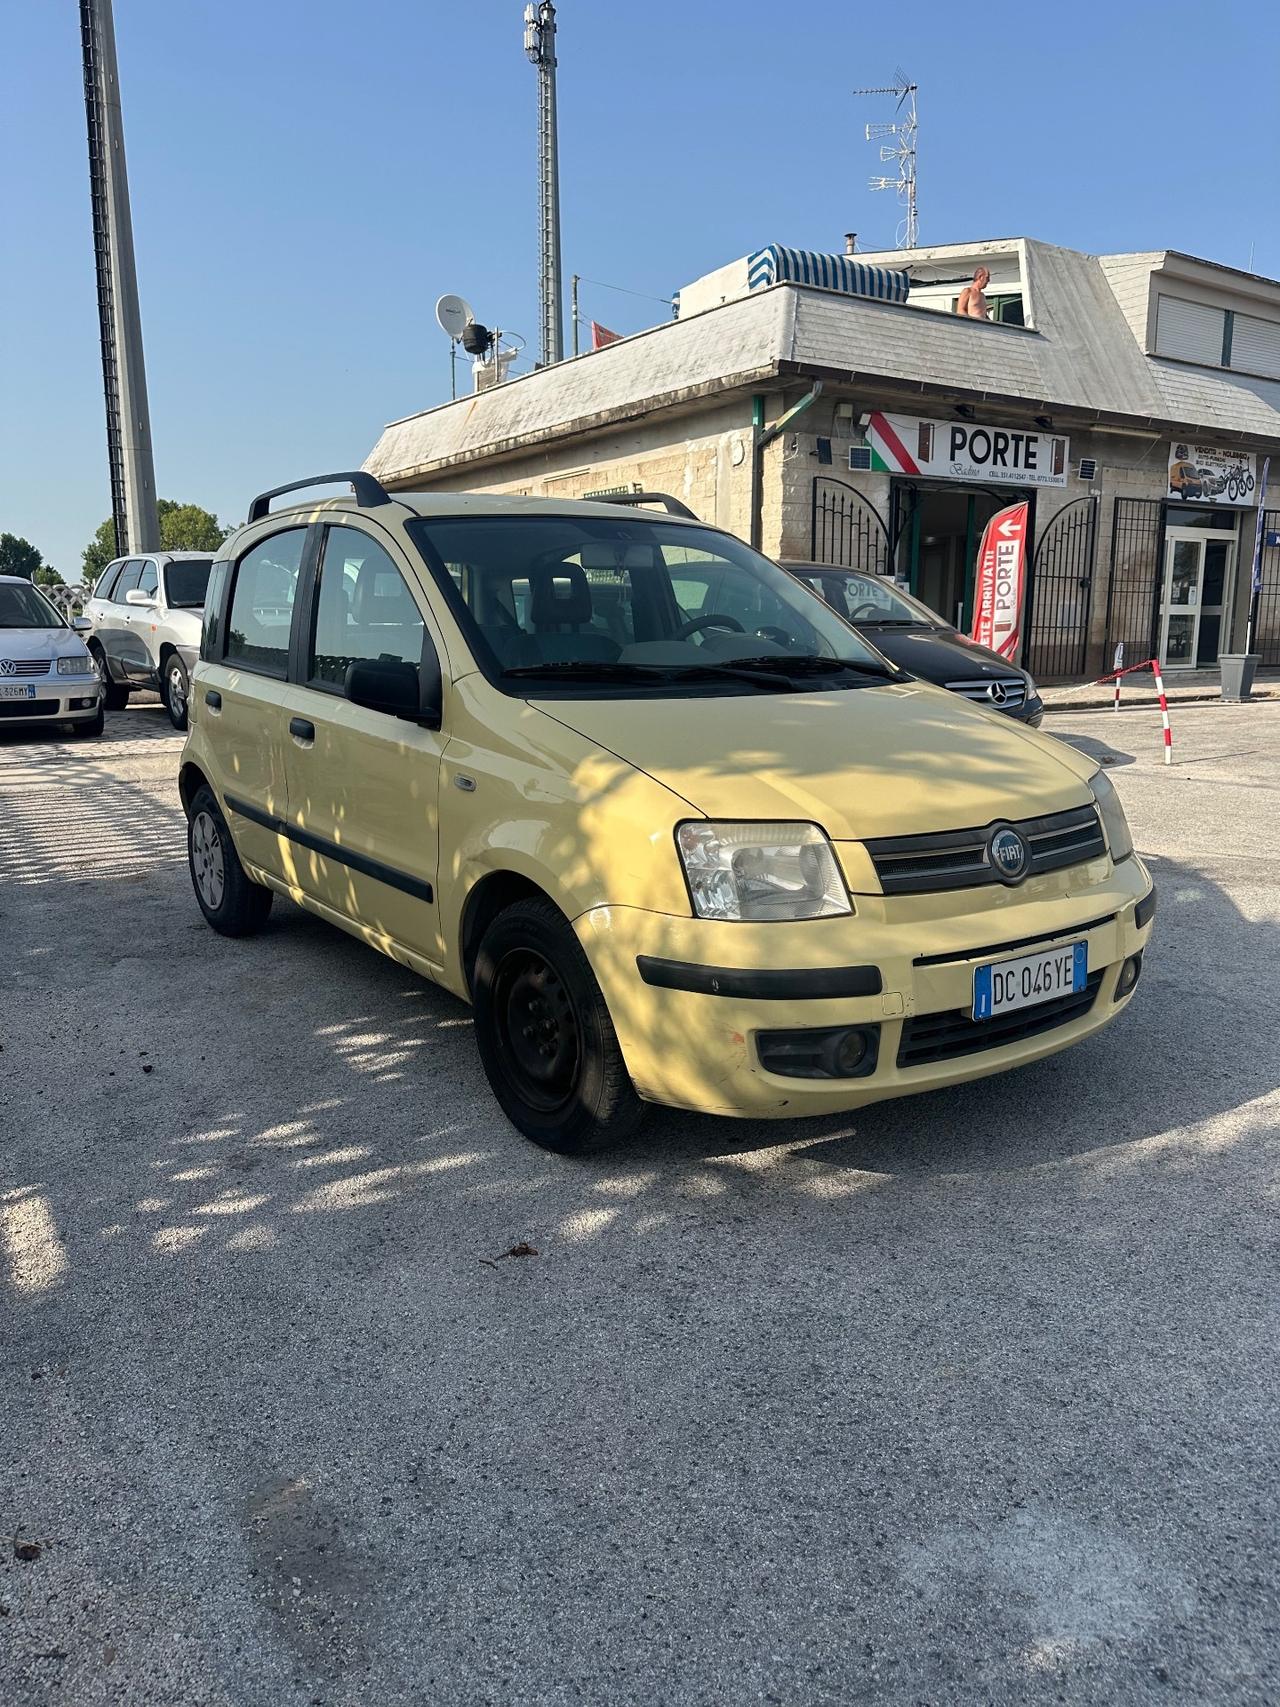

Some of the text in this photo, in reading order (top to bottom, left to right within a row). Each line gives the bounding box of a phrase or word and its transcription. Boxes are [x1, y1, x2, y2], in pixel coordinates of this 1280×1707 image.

[950, 426, 1038, 470] PORTE
[848, 583, 878, 597] ORTE
[996, 545, 1015, 611] PORTE
[999, 843, 1022, 863] FIAT
[993, 970, 1015, 1005] DC
